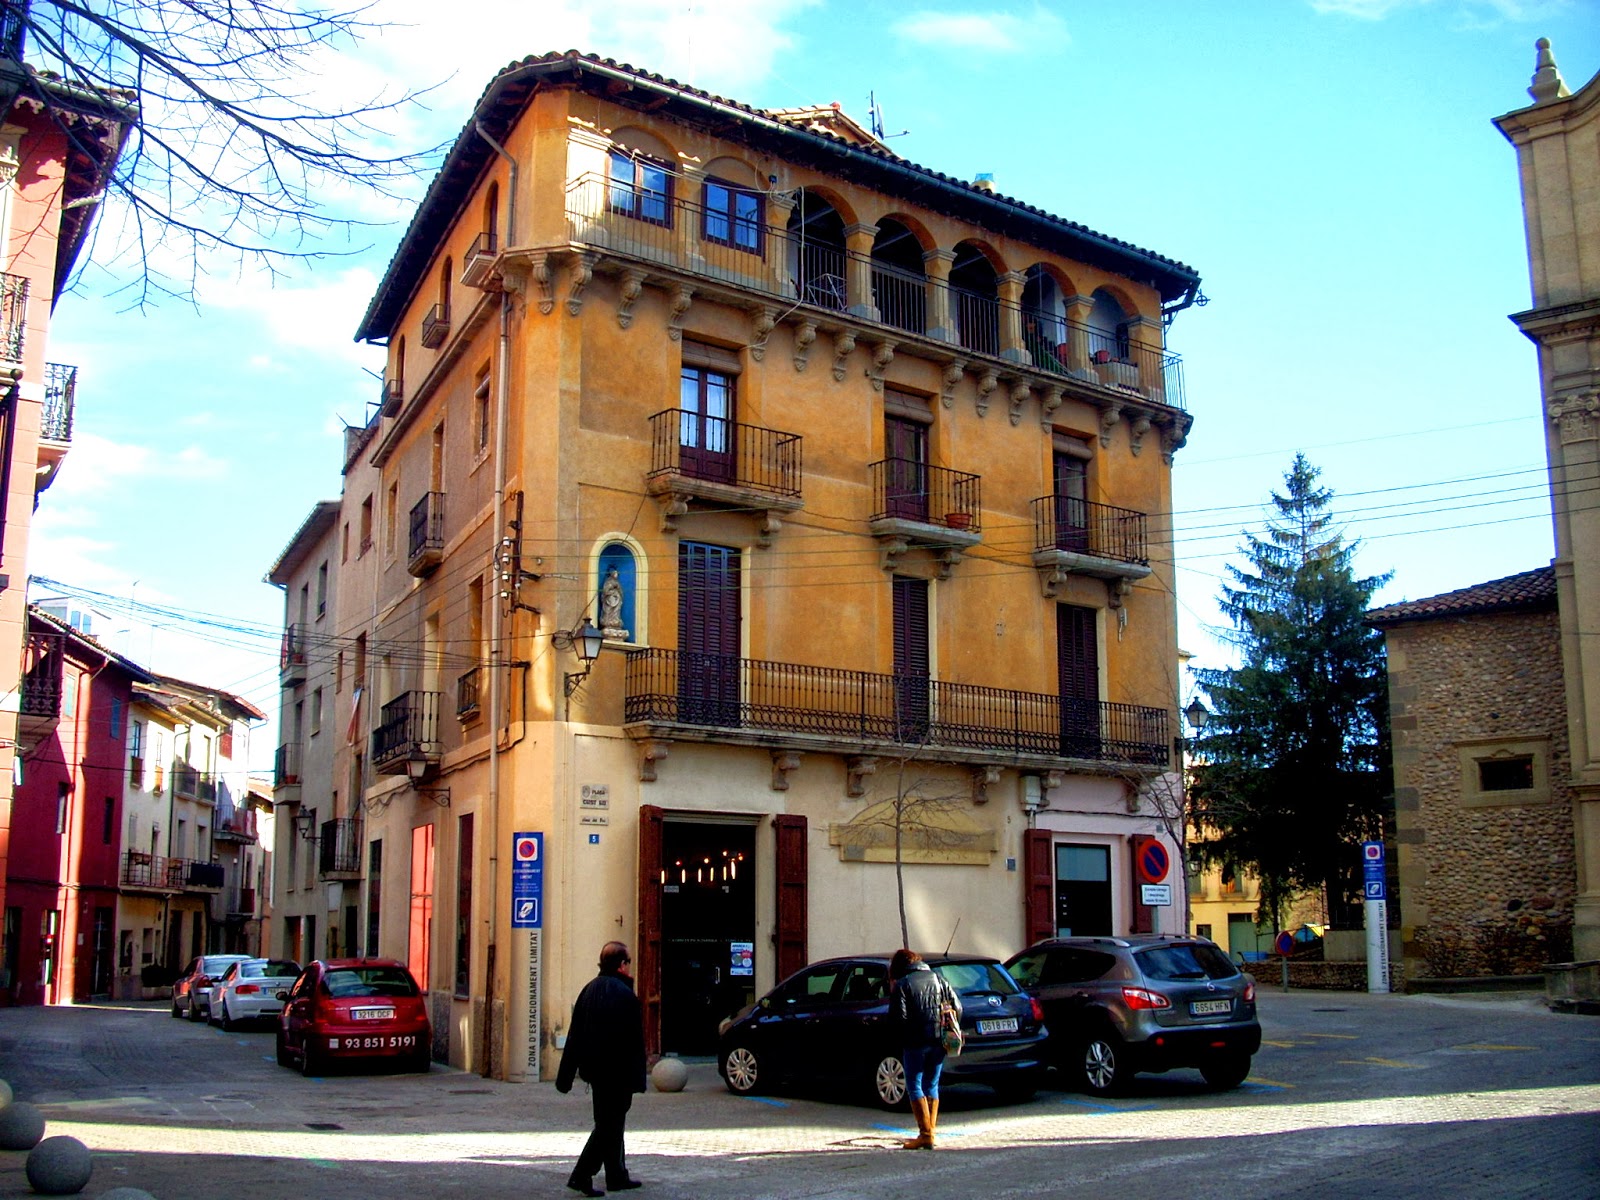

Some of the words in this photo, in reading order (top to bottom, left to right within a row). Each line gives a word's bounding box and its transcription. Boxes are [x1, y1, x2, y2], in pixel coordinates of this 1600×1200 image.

[530, 932, 538, 964] LIMITAT
[529, 966, 538, 1043] D'ESTACIONAMENT
[345, 1038, 360, 1049] 93
[364, 1037, 385, 1048] 851
[389, 1035, 416, 1047] 5191
[528, 1045, 536, 1067] ZONA
